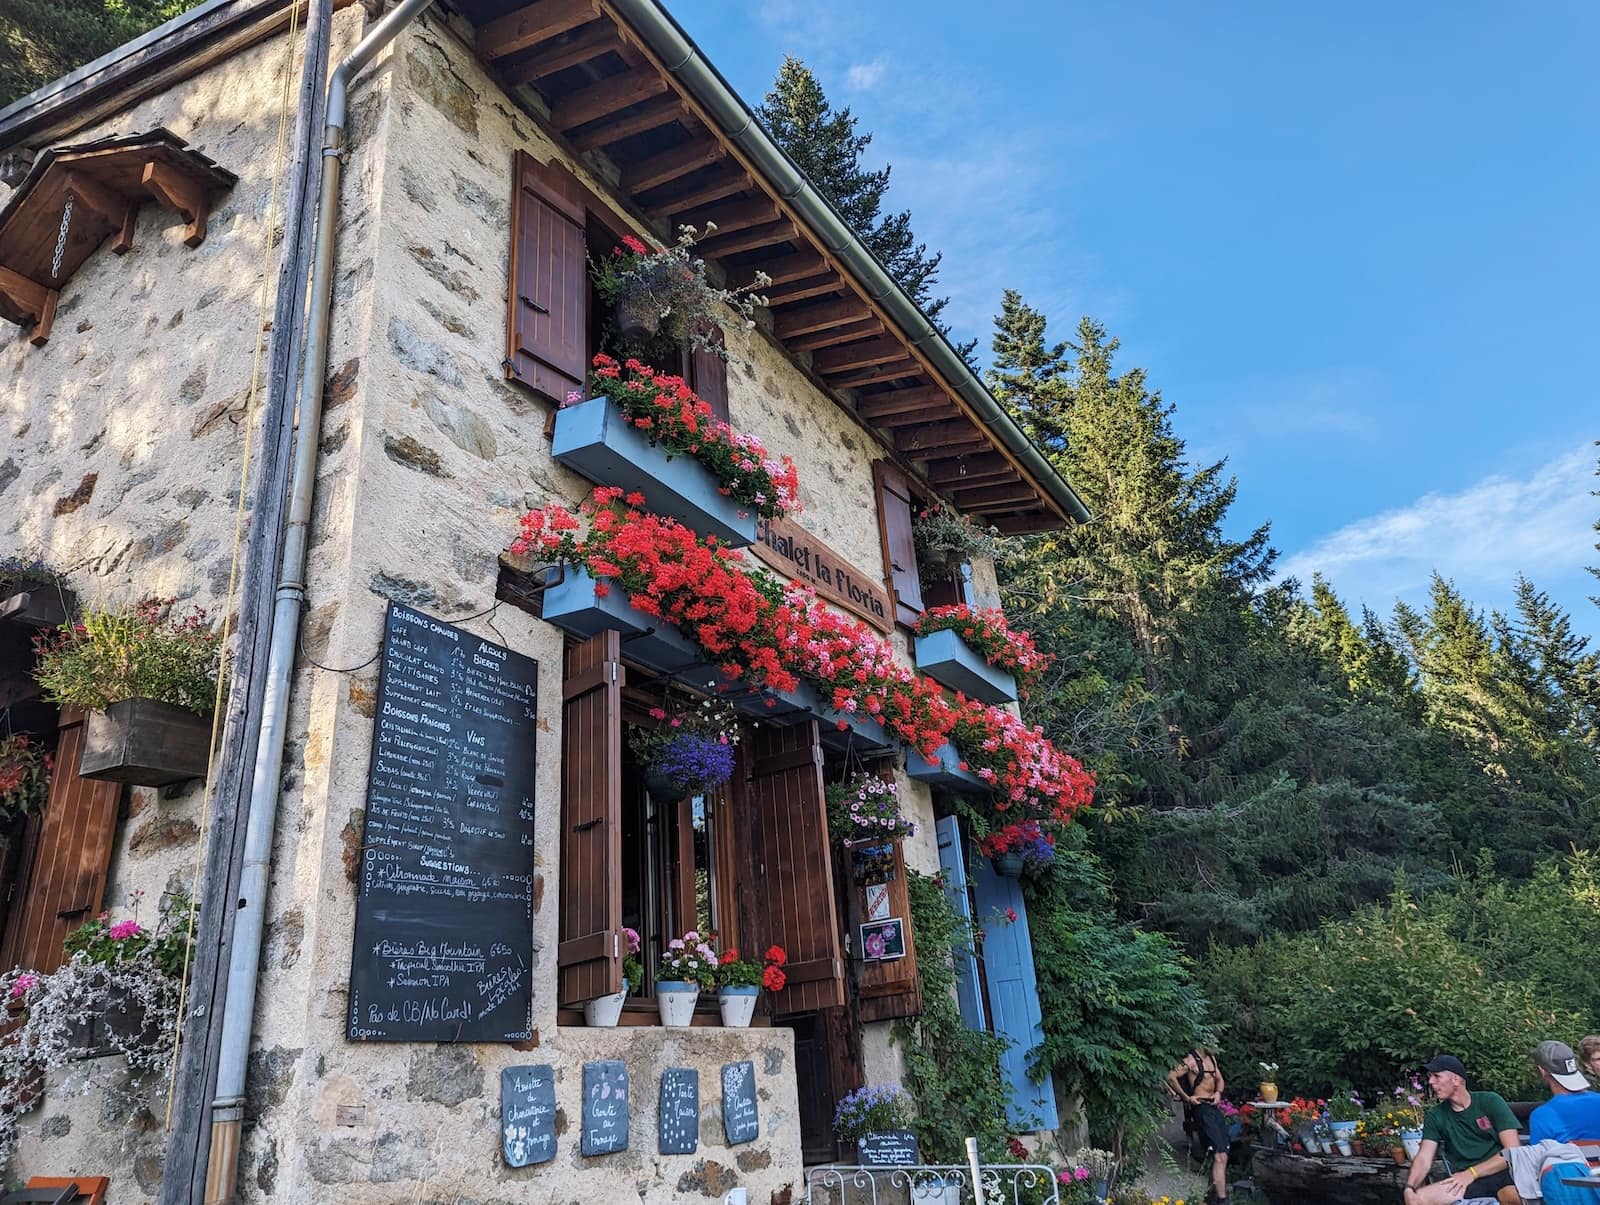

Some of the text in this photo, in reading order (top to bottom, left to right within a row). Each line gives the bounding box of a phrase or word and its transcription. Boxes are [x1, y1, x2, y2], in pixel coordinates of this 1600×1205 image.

[815, 554, 832, 586] la
[836, 568, 884, 618] Floria
[466, 962, 485, 973] IPA
[431, 975, 450, 987] IPA
[368, 1003, 384, 1023] Pas
[386, 1003, 401, 1022] de
